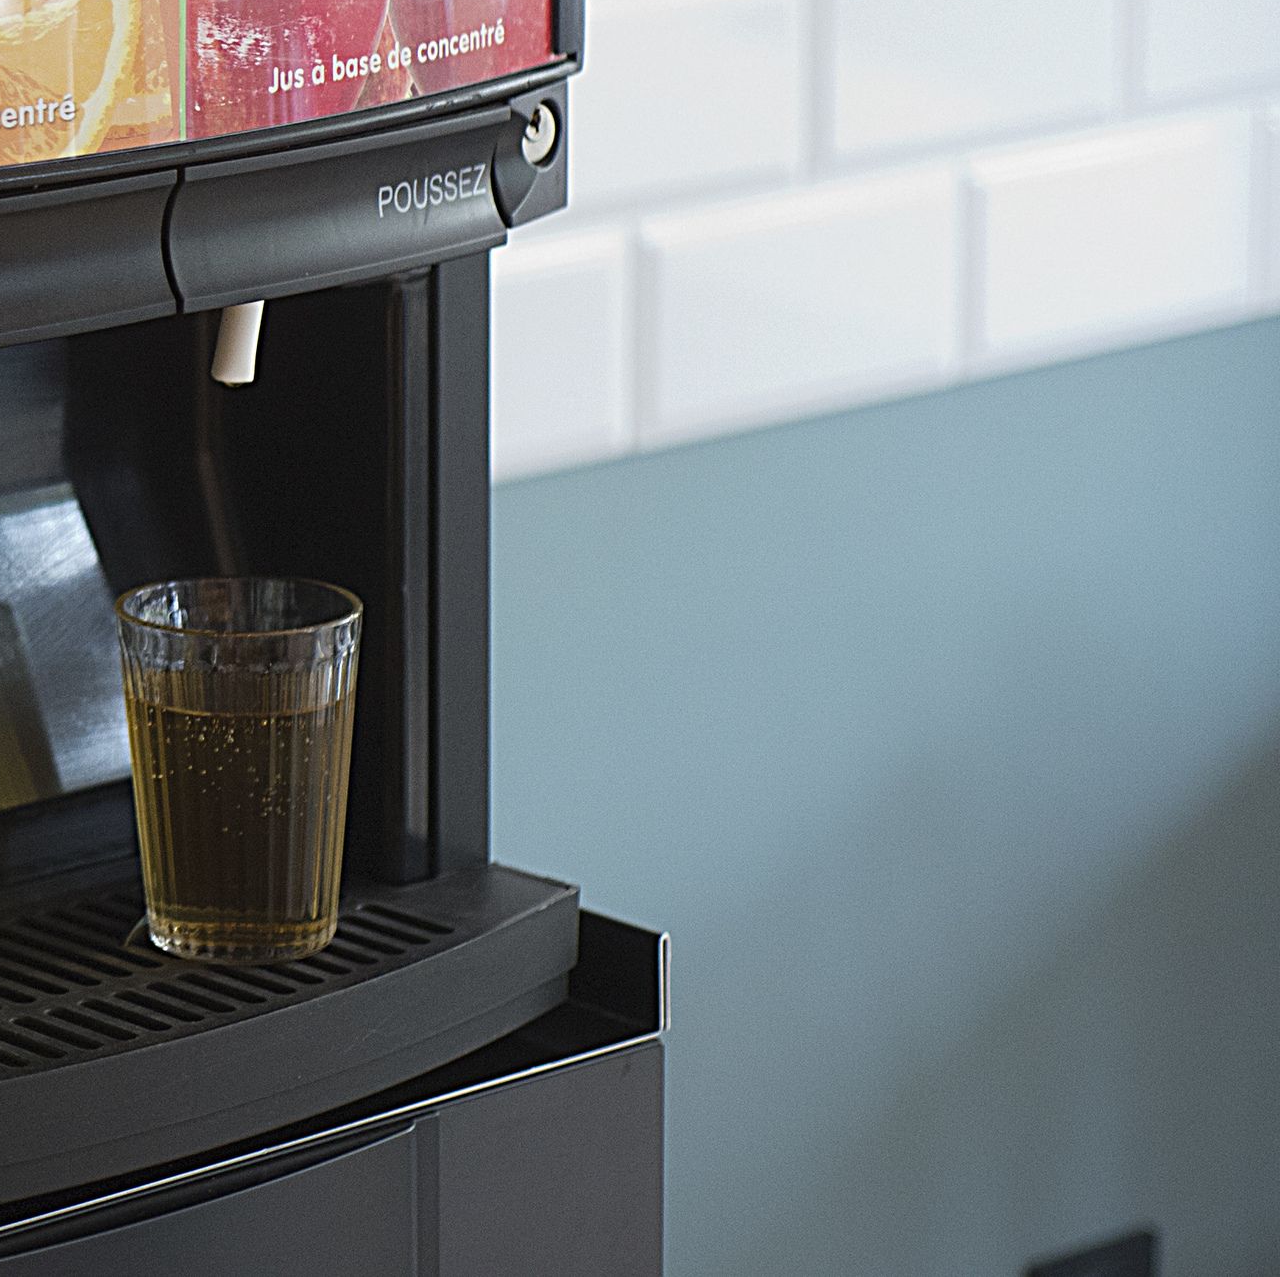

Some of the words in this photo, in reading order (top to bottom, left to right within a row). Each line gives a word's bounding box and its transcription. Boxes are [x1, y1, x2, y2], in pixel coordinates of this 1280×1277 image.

[267, 67, 305, 94] Jus
[311, 61, 325, 85] à
[332, 54, 382, 82] base
[388, 41, 412, 70] de
[417, 17, 506, 63] concentré
[378, 162, 487, 218] POUSSEZ
